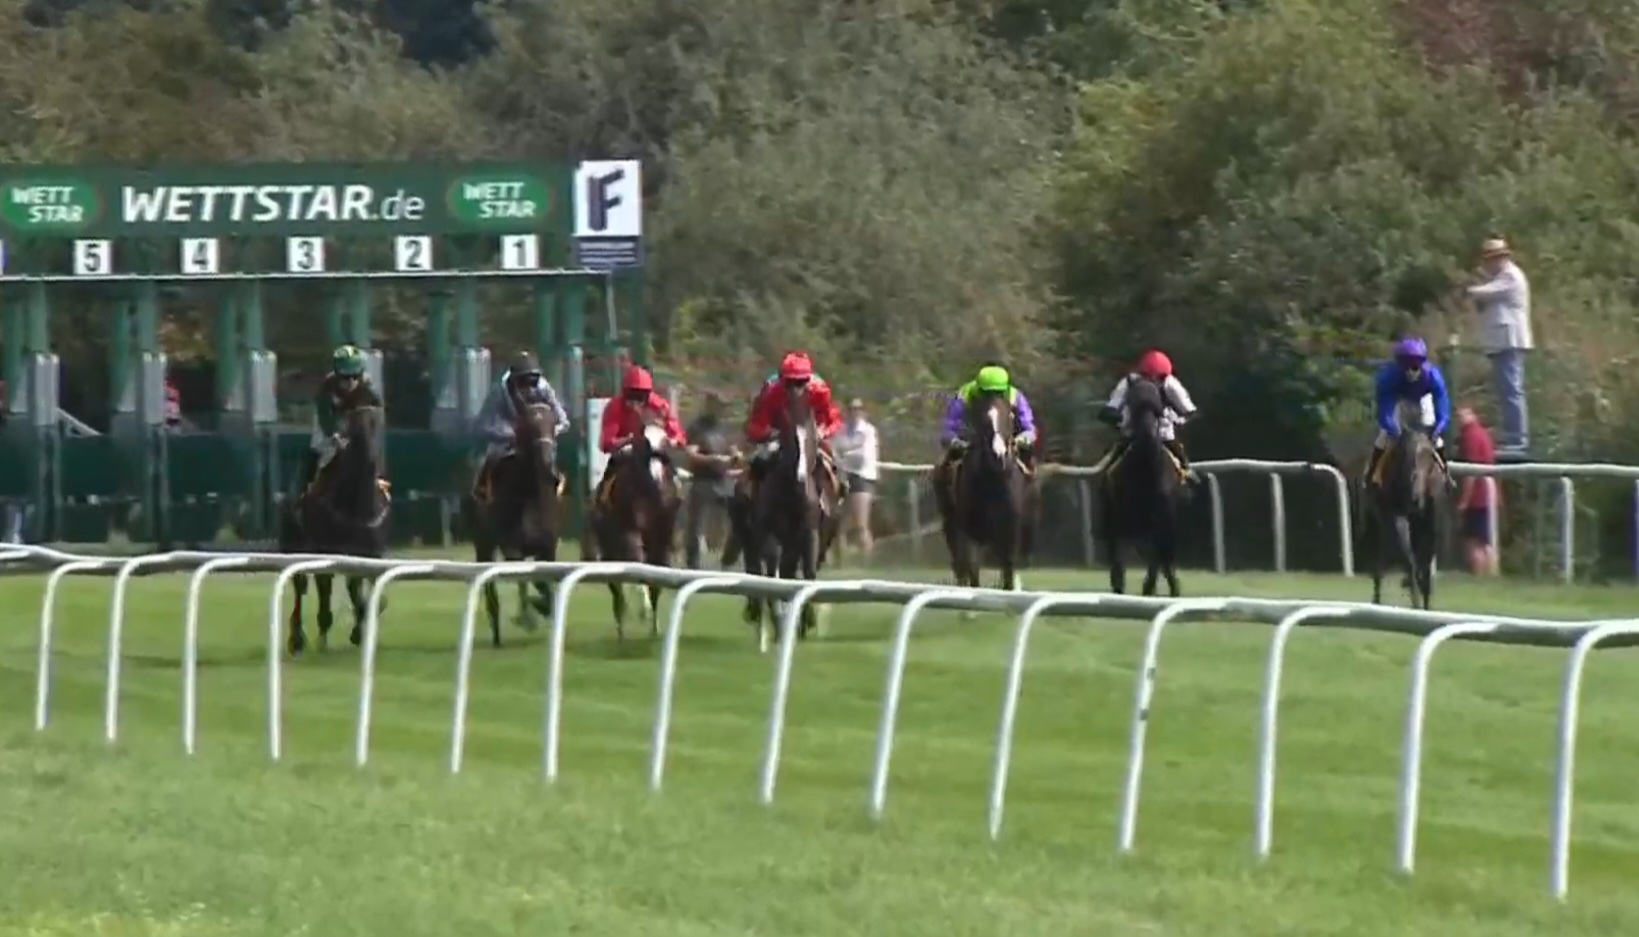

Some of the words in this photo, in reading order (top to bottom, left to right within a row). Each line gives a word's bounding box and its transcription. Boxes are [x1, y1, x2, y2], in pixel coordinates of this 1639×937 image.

[11, 186, 73, 204] WETT
[122, 184, 426, 223] WETTSTAR.de
[462, 182, 525, 200] WETT
[28, 205, 84, 223] STAR
[479, 201, 536, 218] STAR
[84, 243, 102, 272] 5
[191, 241, 209, 271] 4
[296, 241, 315, 269] 3
[404, 239, 423, 268] 2
[511, 239, 527, 267] 1
